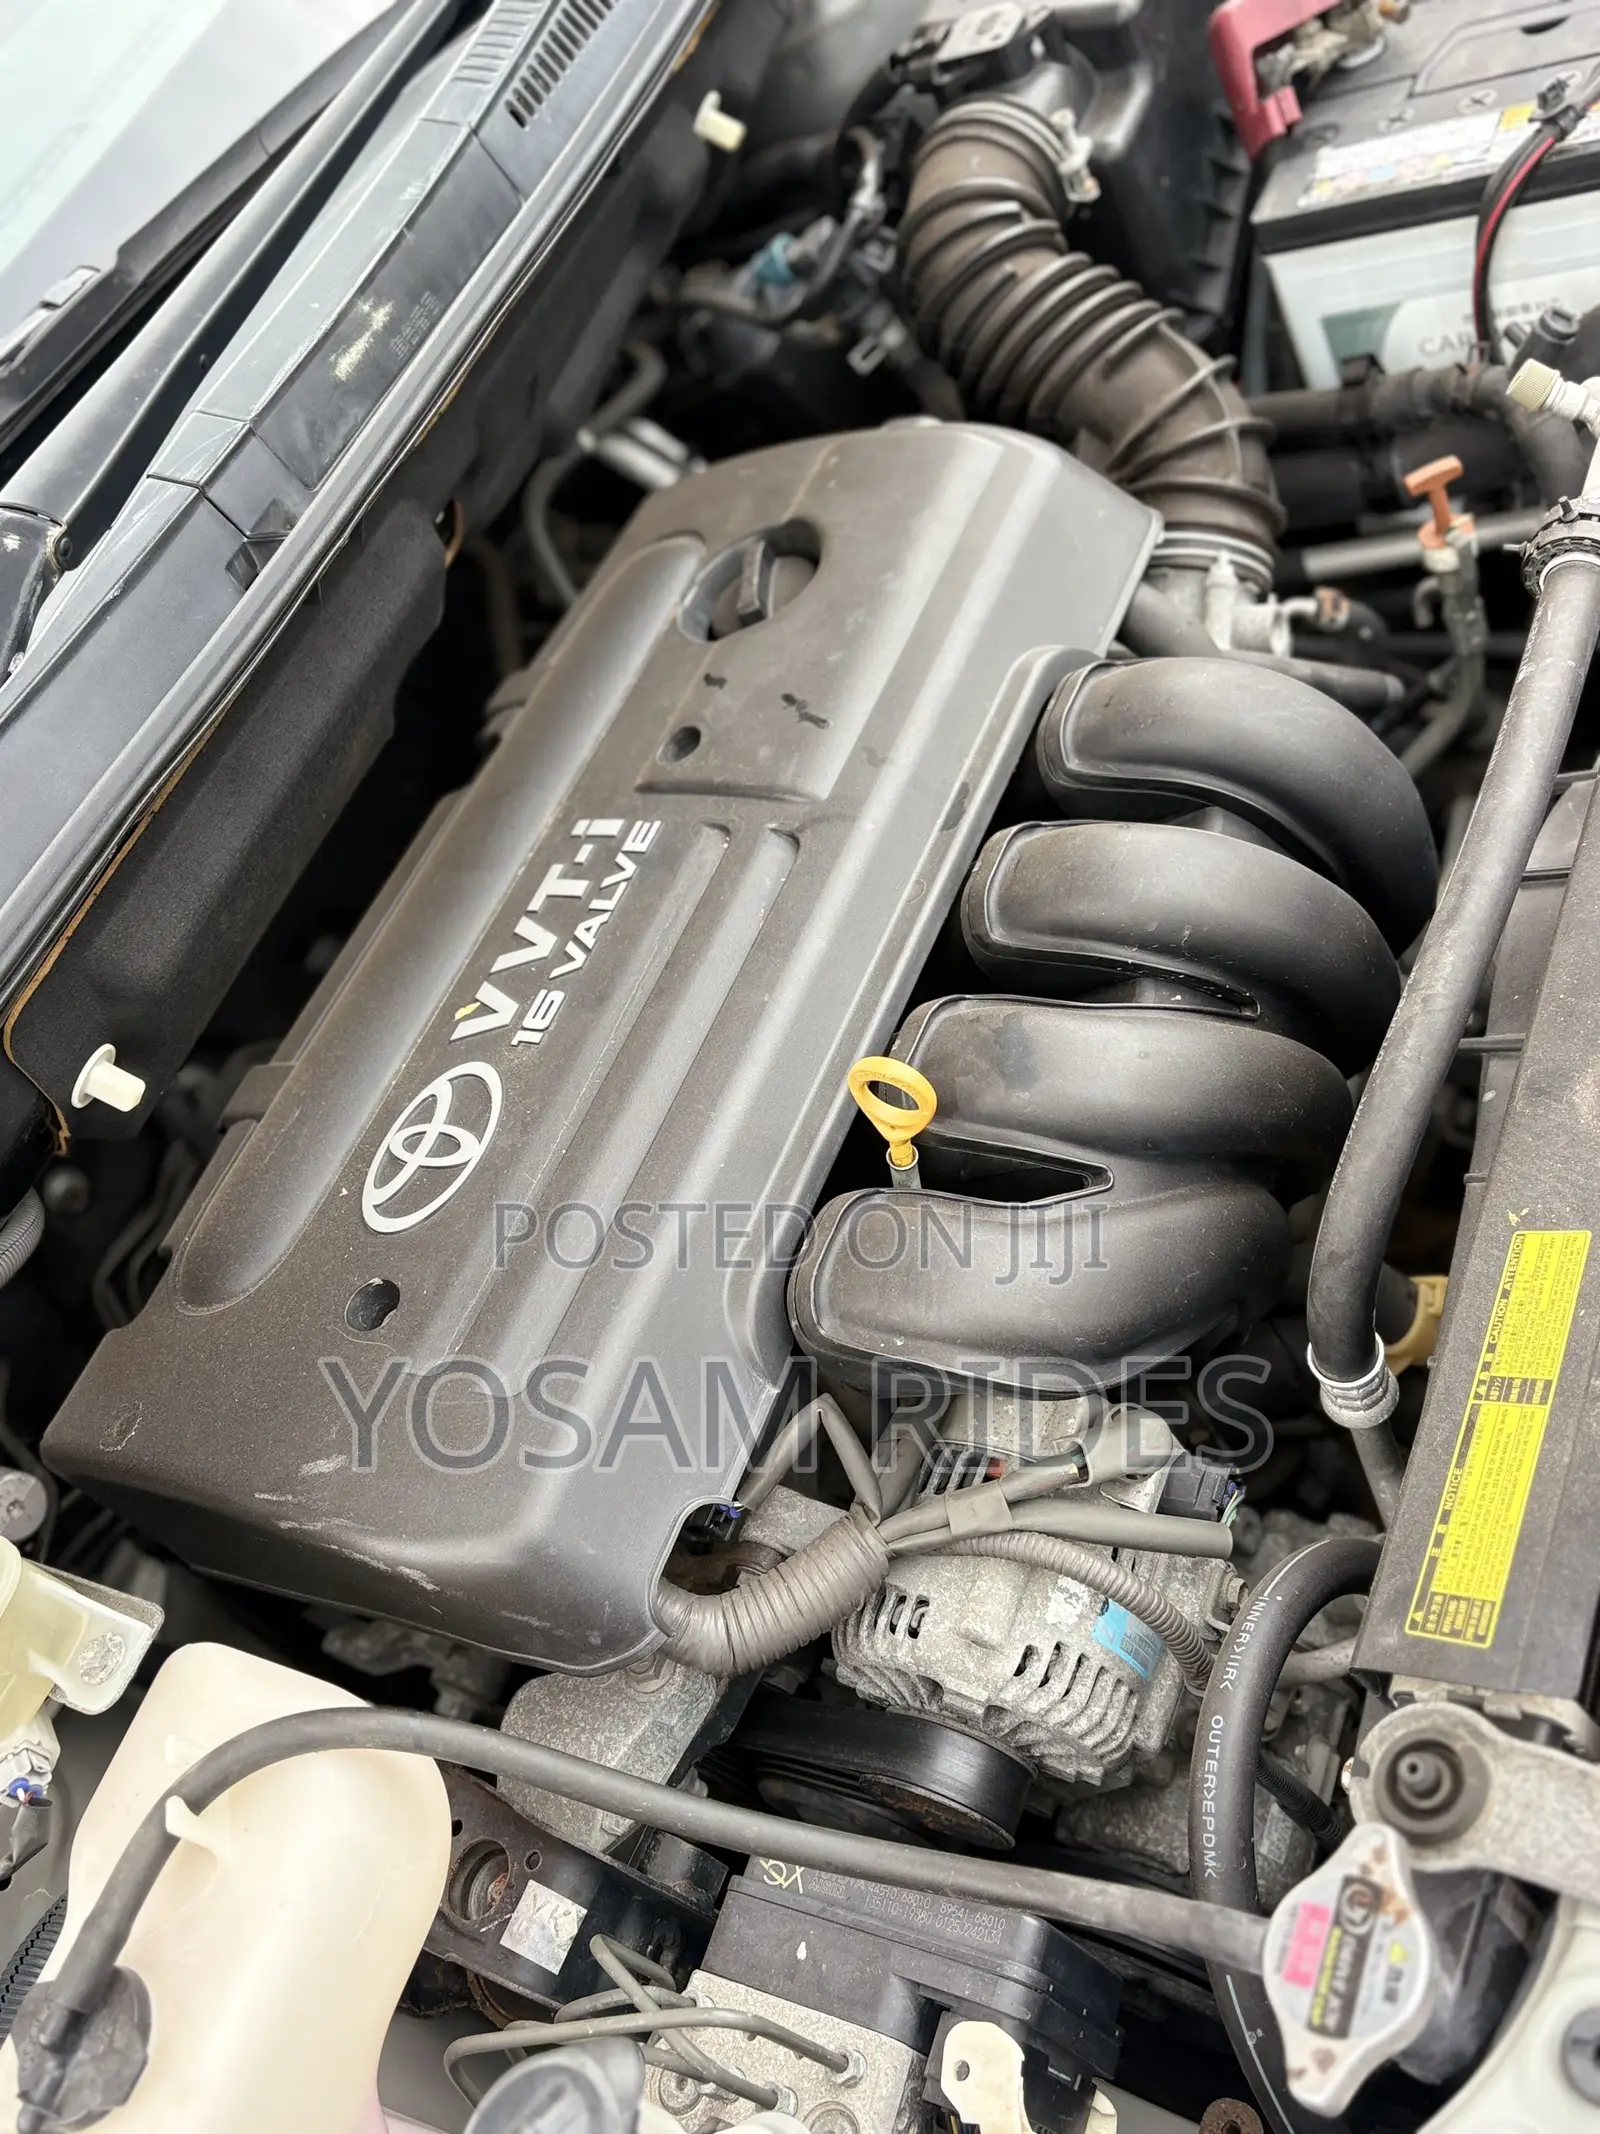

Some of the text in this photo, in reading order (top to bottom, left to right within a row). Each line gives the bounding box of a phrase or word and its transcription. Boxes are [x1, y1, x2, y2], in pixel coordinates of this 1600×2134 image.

[511, 820, 662, 1047] 16 VALVE
[1490, 1297, 1509, 1344] CAUTION
[1503, 1235, 1525, 1291] ATTENTION
[1444, 1467, 1463, 1509] NOTICE
[808, 1877, 846, 1899] AISIN
